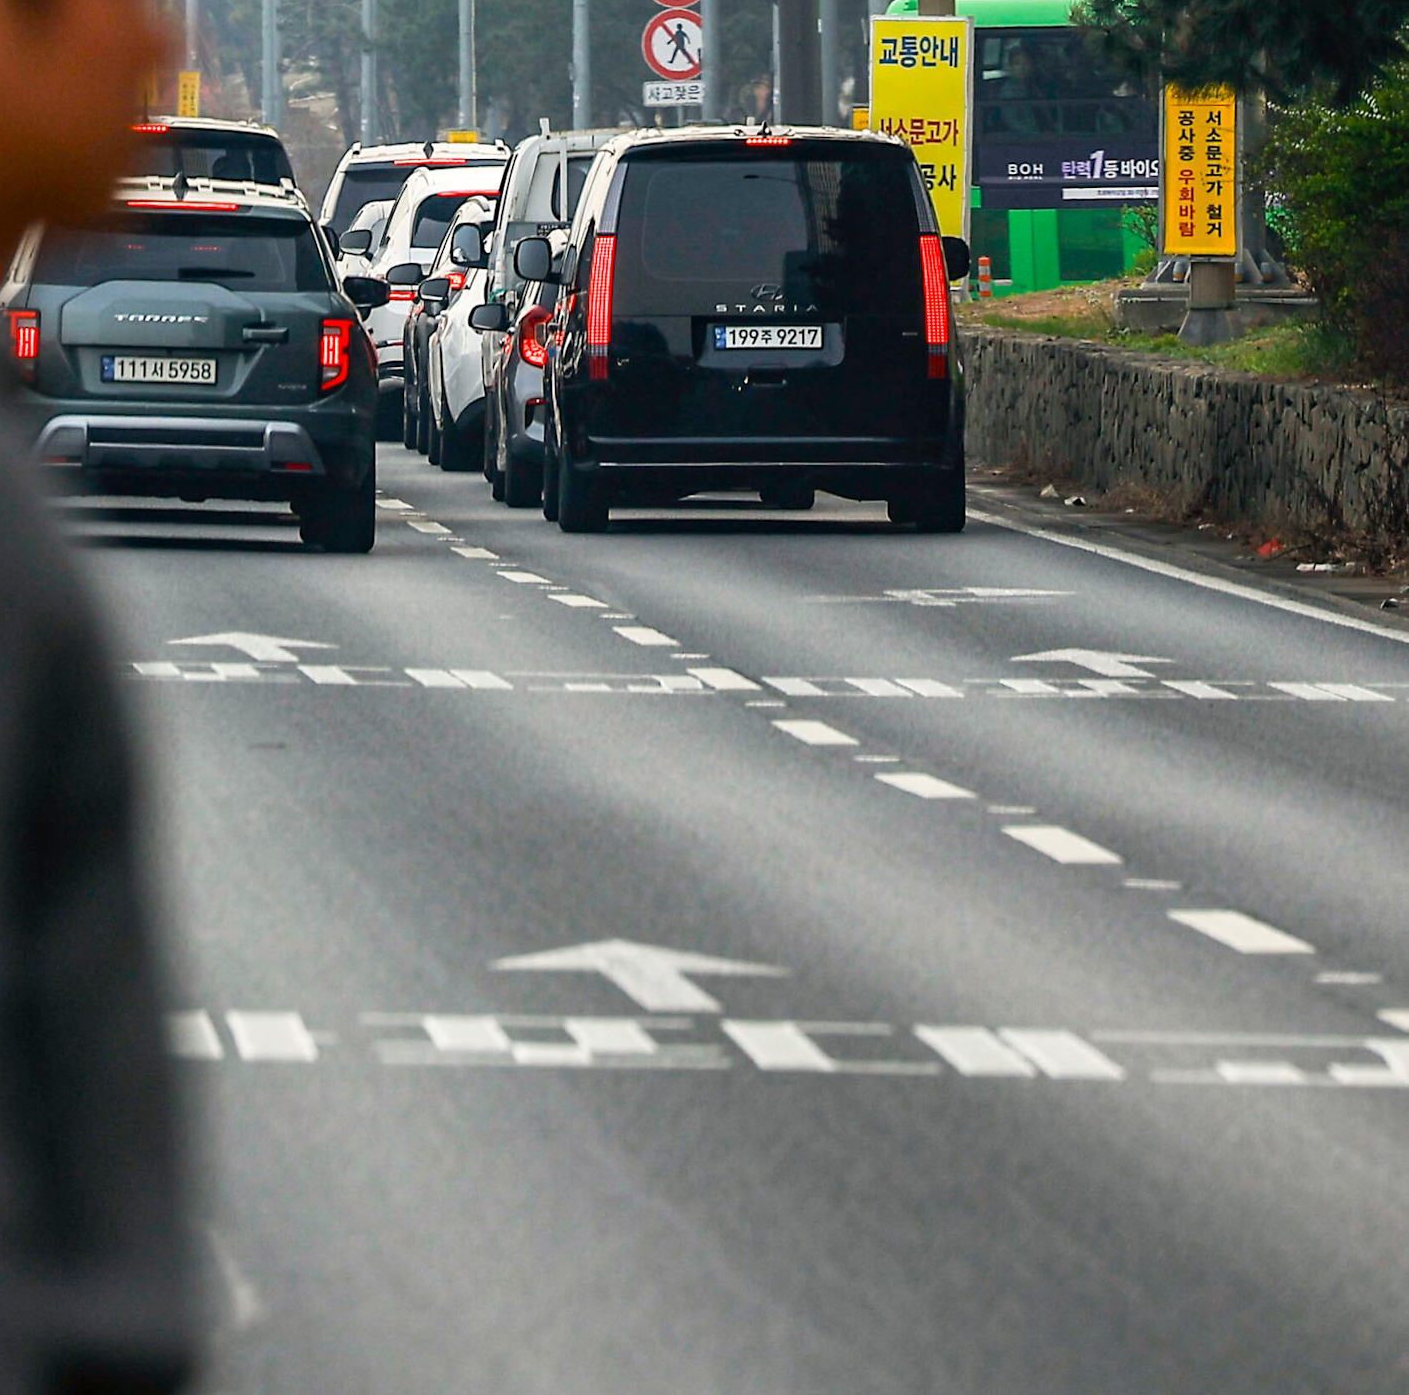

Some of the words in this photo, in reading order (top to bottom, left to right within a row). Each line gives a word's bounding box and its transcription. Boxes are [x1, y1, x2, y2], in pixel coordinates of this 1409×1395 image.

[878, 36, 959, 68] 교통안내
[1178, 110, 1196, 162] 공사중
[1205, 110, 1223, 196] 서소문고가
[1007, 163, 1044, 175] BOH
[1178, 168, 1196, 237] 우회바람
[715, 304, 819, 313] STARIA
[776, 327, 819, 346] 9217
[168, 361, 212, 380] 5958
